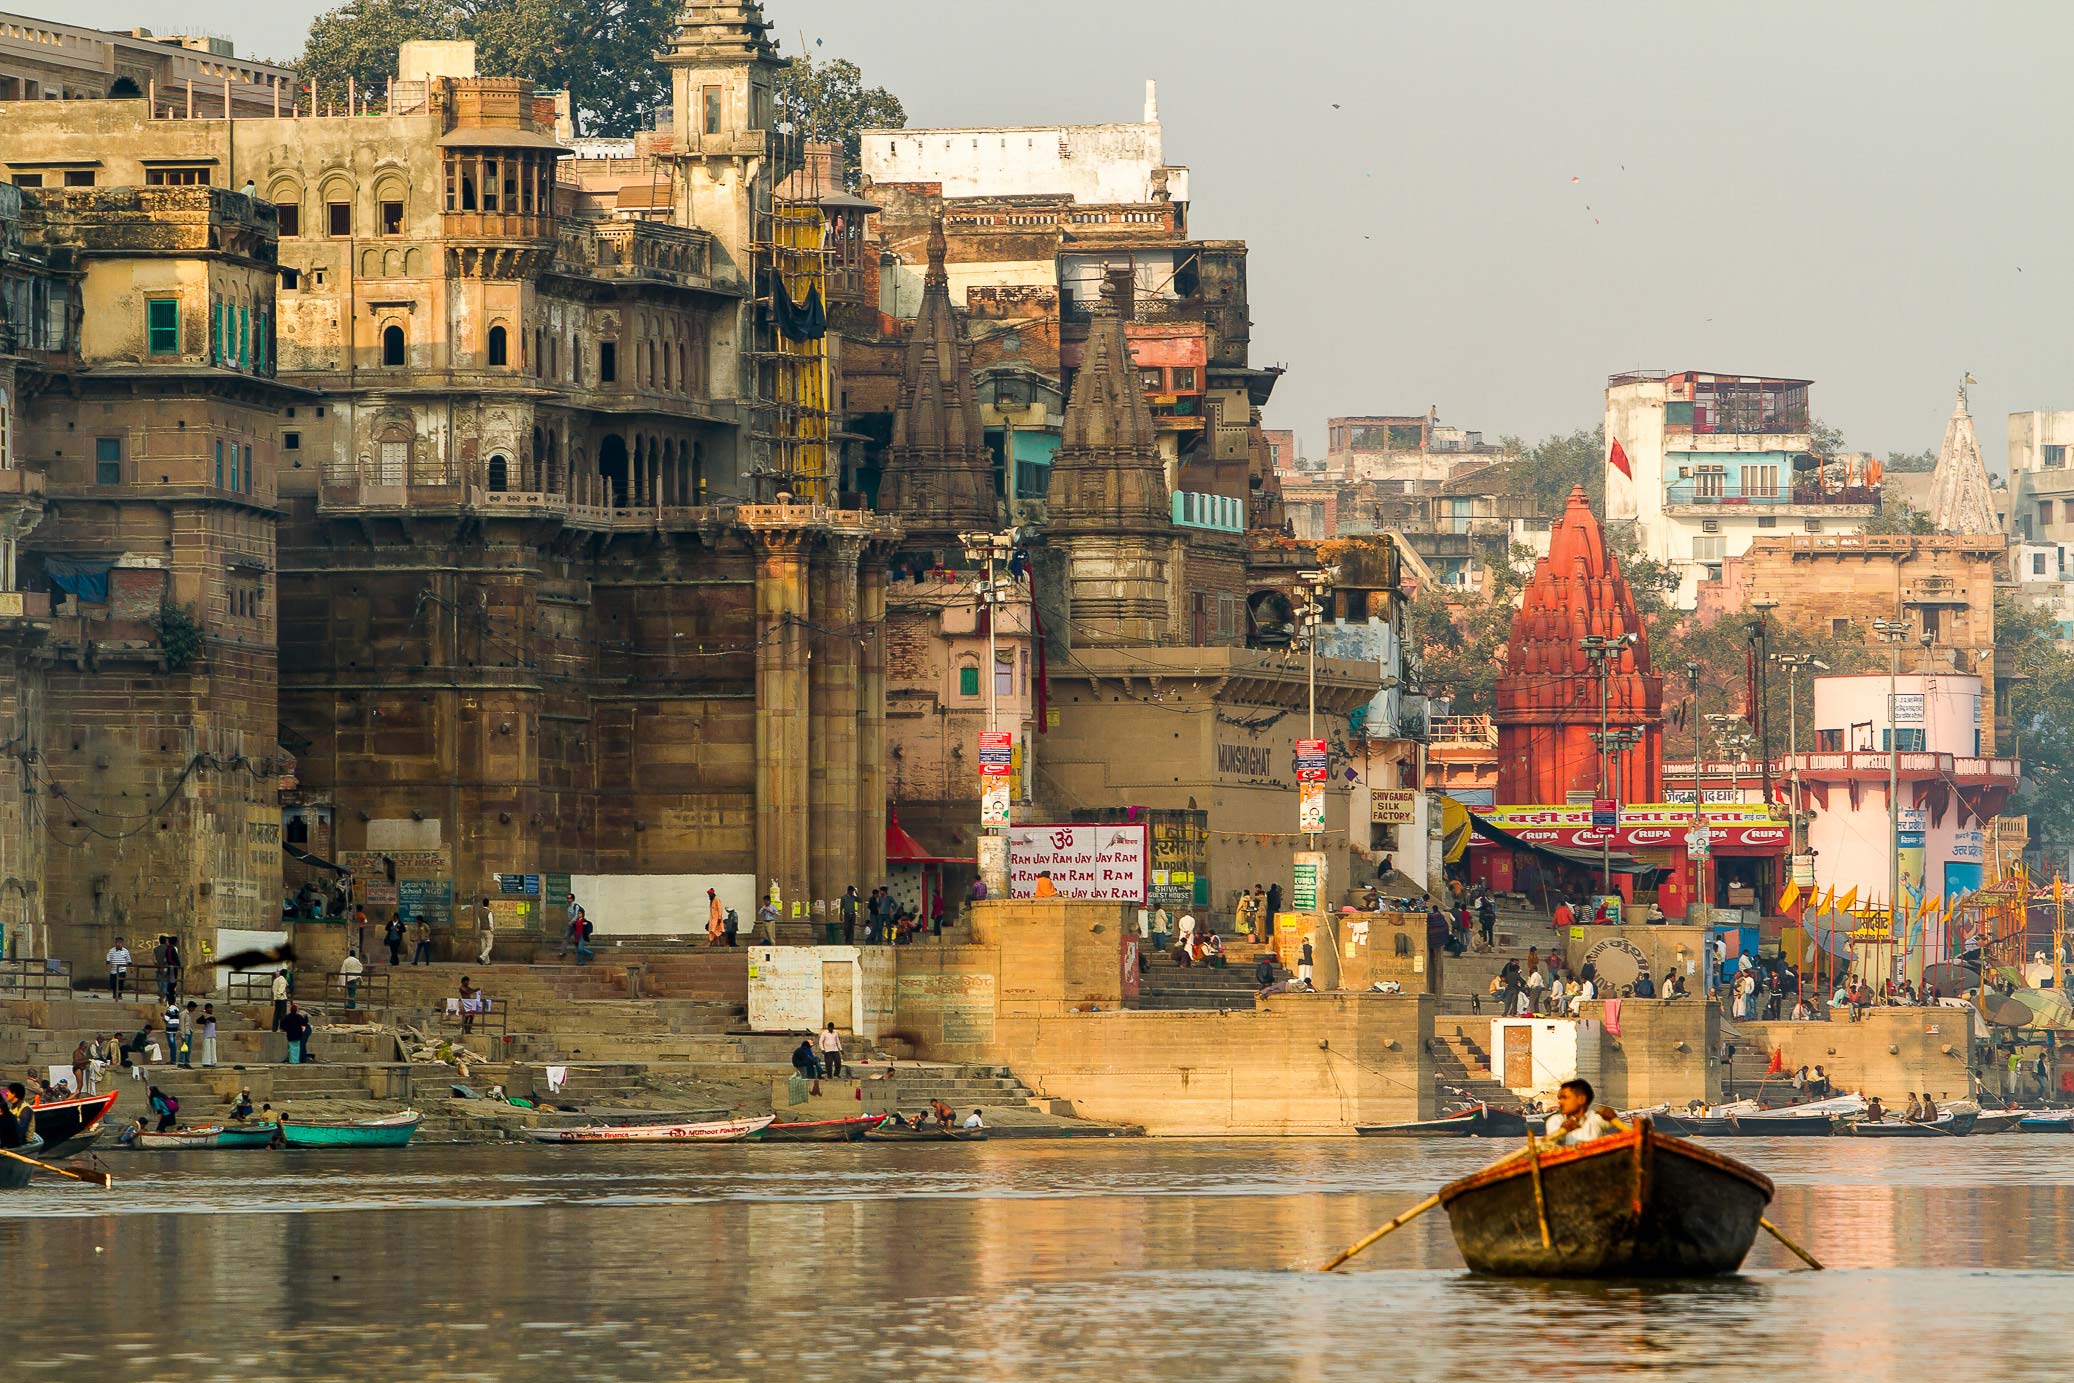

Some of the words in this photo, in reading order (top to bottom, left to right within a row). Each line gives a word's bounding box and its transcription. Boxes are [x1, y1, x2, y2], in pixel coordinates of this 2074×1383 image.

[1372, 792, 1389, 800] SHIV
[1390, 793, 1413, 801] GANGA
[1374, 812, 1410, 820] FACTORY
[1509, 812, 1560, 824] बड़ी
[1566, 812, 1664, 821] शला
[1639, 830, 1671, 838] RUPA
[1952, 846, 1967, 856] उत्तर
[1033, 853, 1050, 864] JAY
[1052, 852, 1072, 864] RAM
[1075, 852, 1092, 863] JAY
[1095, 852, 1112, 863] JAY
[1114, 852, 1137, 863] RAM
[1069, 869, 1094, 880] RAM
[1103, 869, 1133, 880] RAM
[1072, 887, 1088, 898] JAY
[1091, 887, 1107, 898] JAY
[1111, 887, 1138, 898] RAM
